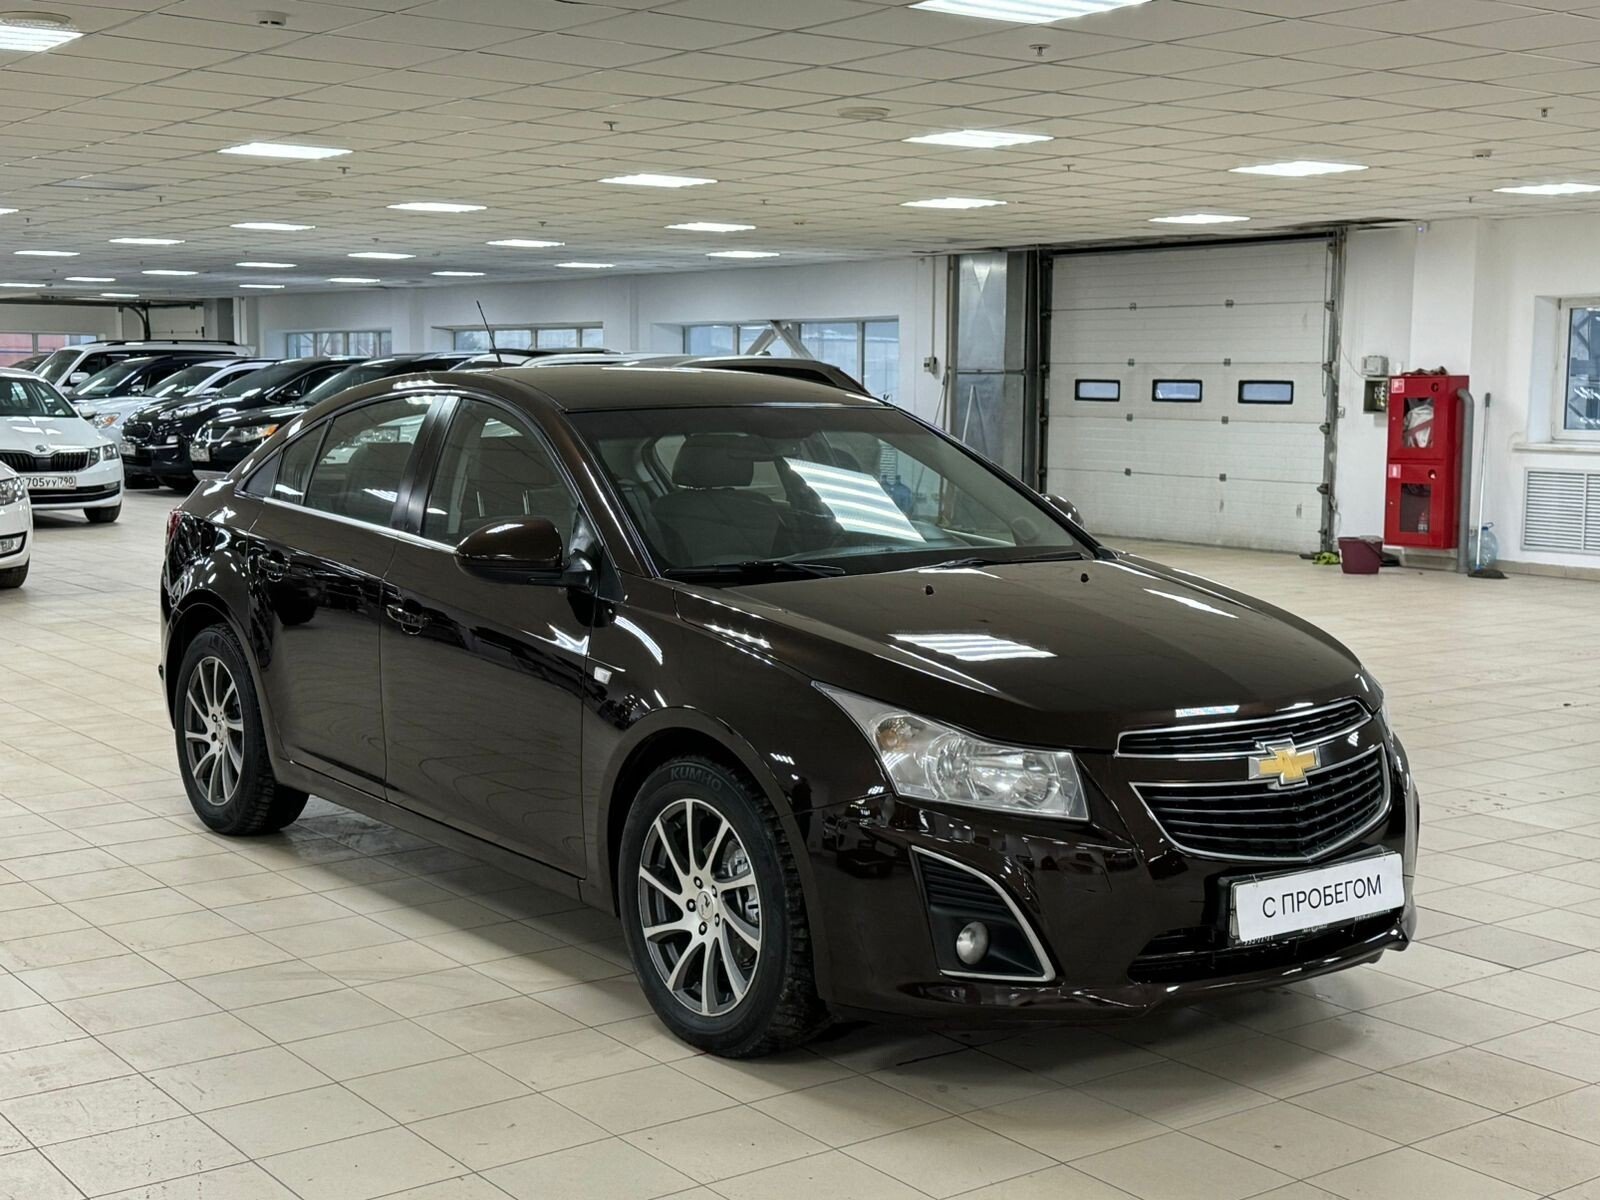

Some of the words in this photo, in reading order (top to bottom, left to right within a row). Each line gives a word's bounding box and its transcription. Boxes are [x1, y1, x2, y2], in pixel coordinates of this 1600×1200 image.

[671, 767, 721, 791] KUMHO
[1262, 896, 1276, 918] С
[1281, 874, 1381, 915] ПРОБЕГОМ
